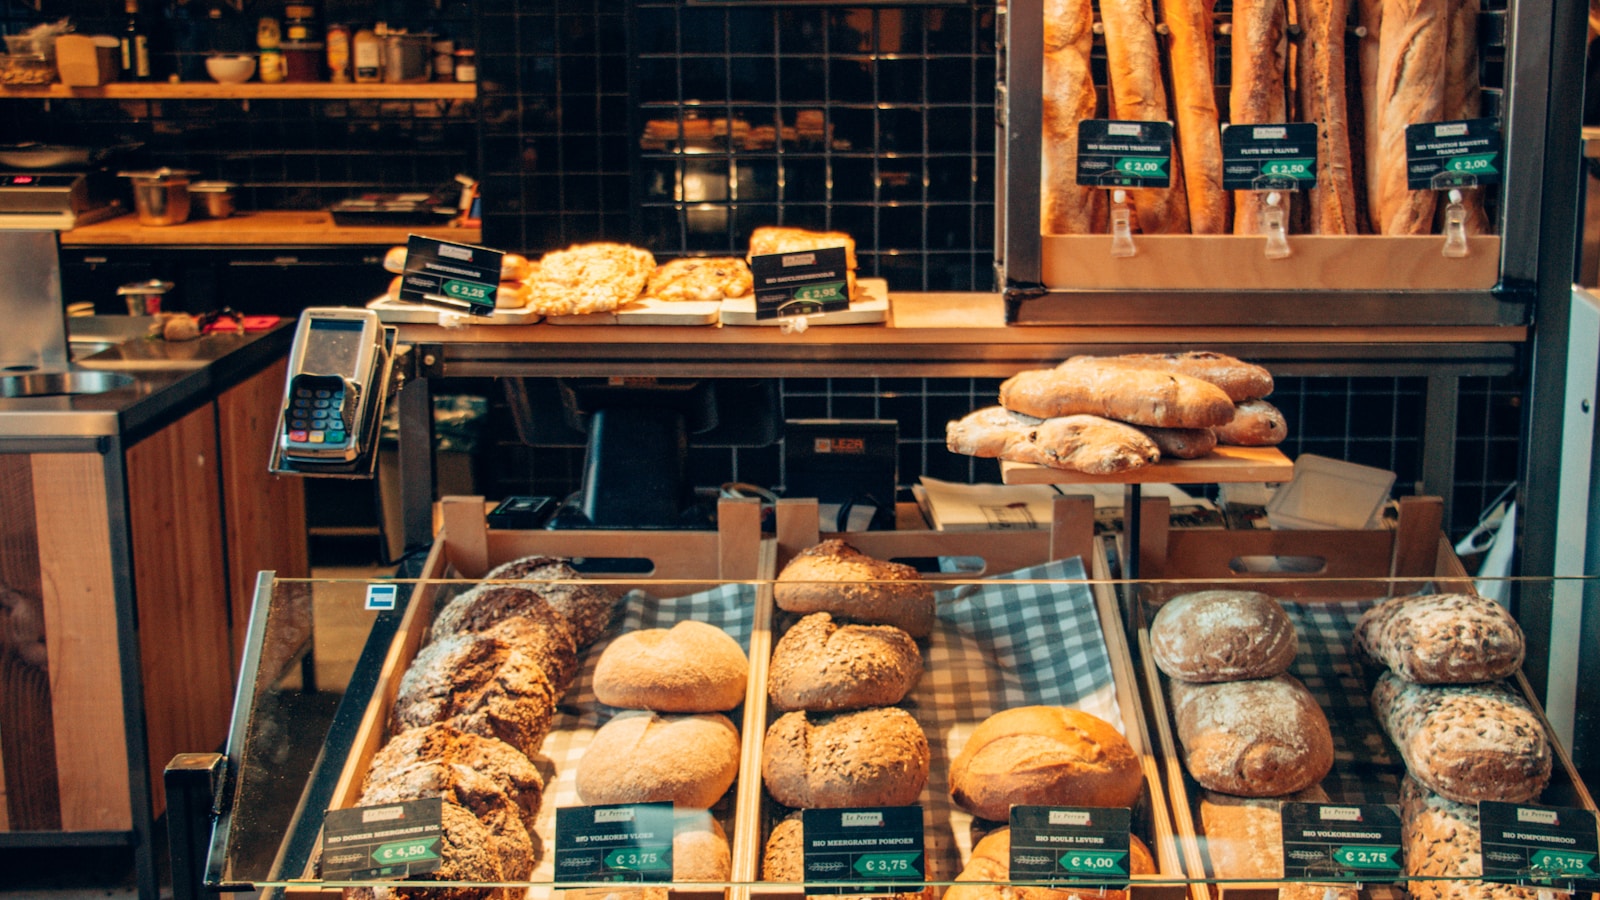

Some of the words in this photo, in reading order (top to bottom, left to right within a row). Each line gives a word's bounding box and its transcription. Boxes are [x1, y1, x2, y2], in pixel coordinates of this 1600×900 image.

[1124, 162, 1132, 170] €
[1134, 162, 1158, 172] 2,00
[1271, 165, 1279, 173] €
[1281, 164, 1304, 174] 2,50
[1454, 161, 1462, 170] €
[1464, 159, 1488, 170] 2,00
[451, 284, 460, 293] €
[461, 285, 485, 298] 2,25
[802, 291, 811, 299] €
[813, 288, 837, 298] 2,95
[1075, 836, 1104, 844] LEVURE
[1317, 830, 1382, 839] VOLKORENBROOD
[1502, 831, 1516, 839] BIO
[1517, 832, 1576, 844] POMPOENBROOD
[827, 839, 877, 847] MEERGRANEN
[383, 849, 393, 858] €
[396, 845, 426, 858] 4,50
[616, 855, 625, 865] €
[628, 853, 657, 865] 3,75
[1071, 857, 1080, 866] €
[1084, 857, 1113, 869] 4,00
[1345, 852, 1354, 862] €
[1357, 852, 1388, 863] 2,75
[866, 861, 875, 871] €
[878, 860, 908, 872] 3,75
